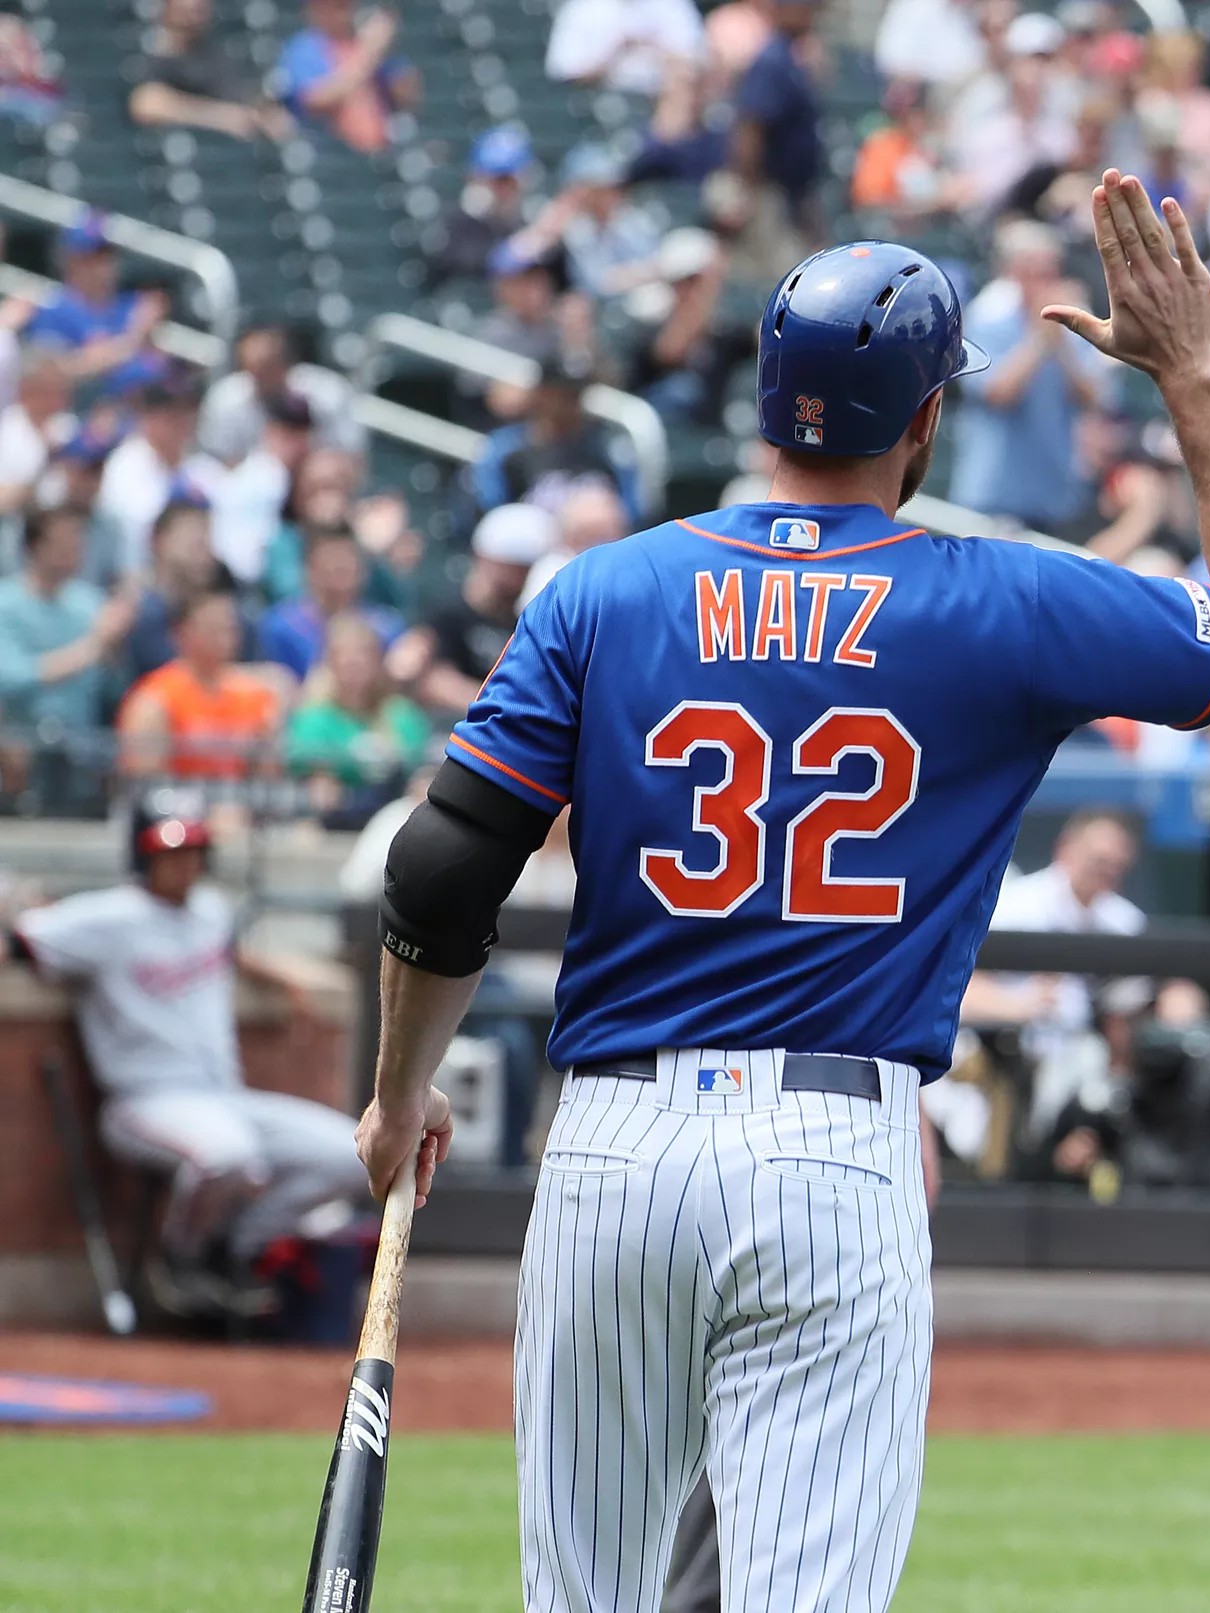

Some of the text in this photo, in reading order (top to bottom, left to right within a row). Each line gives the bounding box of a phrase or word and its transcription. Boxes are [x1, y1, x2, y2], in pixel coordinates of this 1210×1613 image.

[795, 395, 824, 424] 32
[695, 568, 893, 669] MATZ
[639, 700, 922, 923] 32
[340, 1389, 356, 1451] marucci
[331, 1566, 350, 1606] Steven
